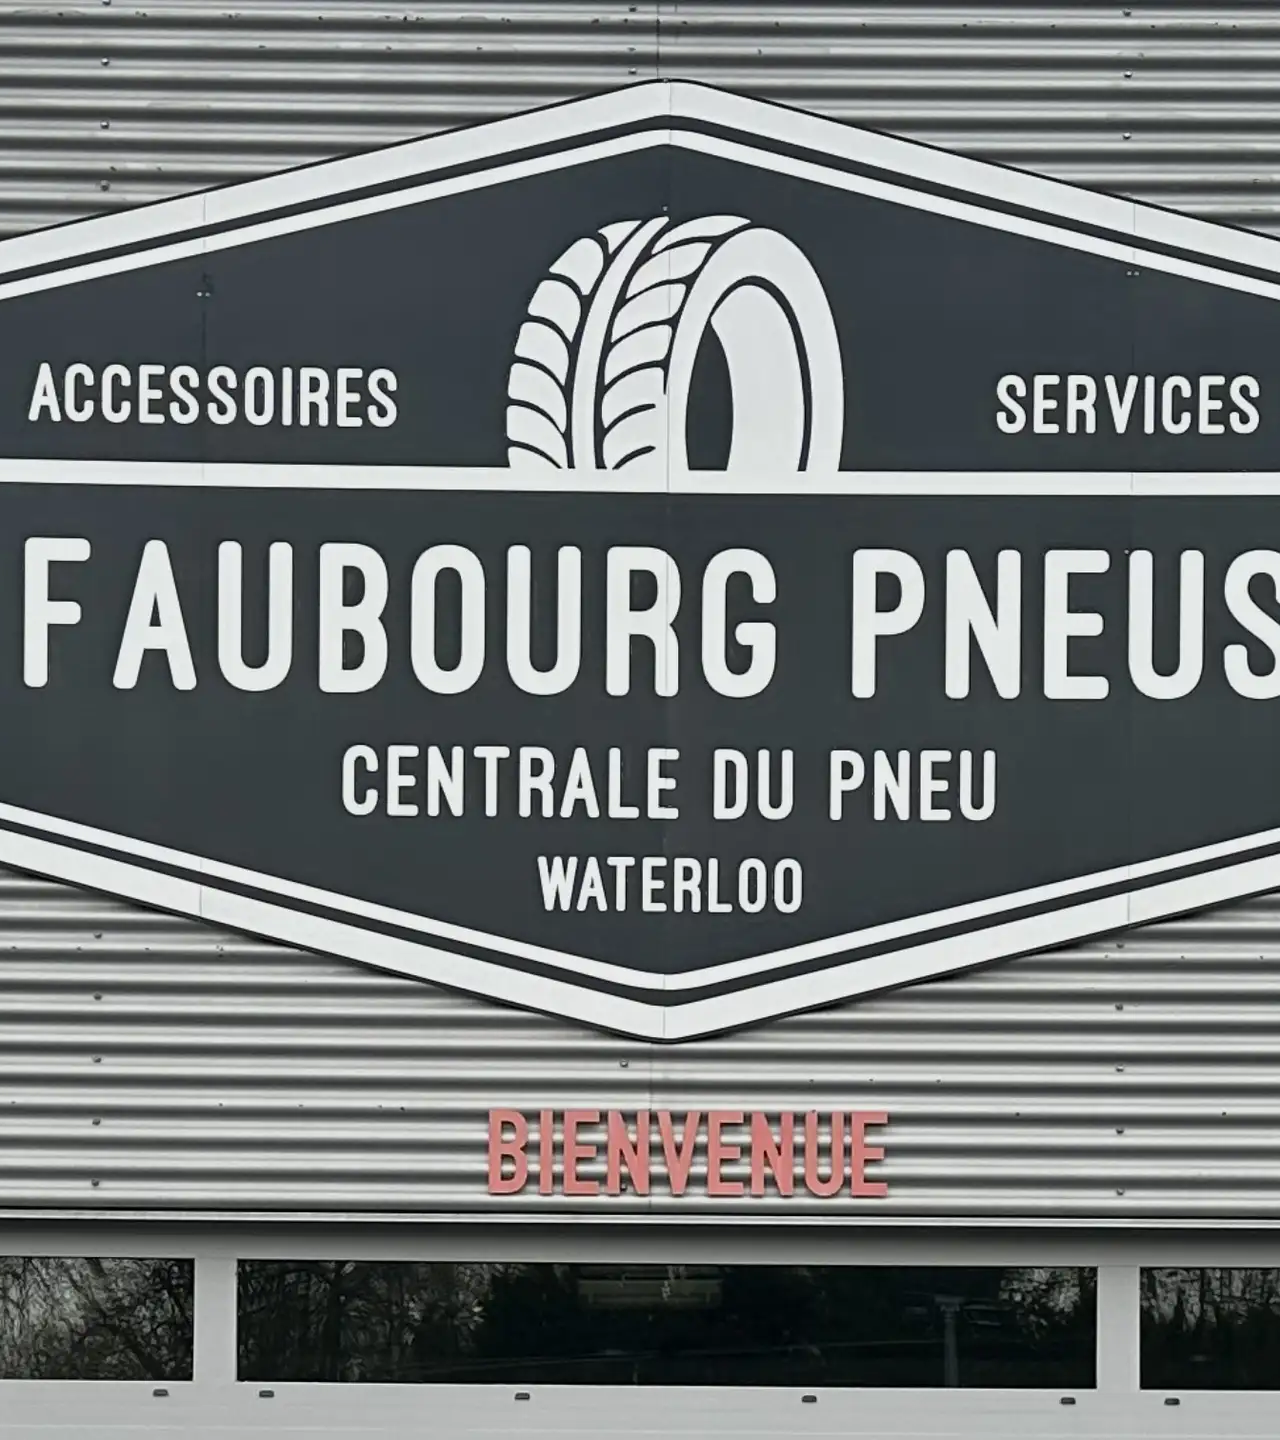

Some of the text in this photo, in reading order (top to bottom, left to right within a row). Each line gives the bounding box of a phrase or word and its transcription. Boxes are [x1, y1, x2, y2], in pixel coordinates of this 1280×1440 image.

[28, 362, 399, 428] ACCESSOIRES
[996, 374, 1261, 435] SERVICES
[23, 536, 778, 699] FAUBOURG
[341, 744, 998, 822] CENTRALE DU PNEU
[537, 856, 804, 914] WATERLOO
[487, 1107, 890, 1199] BIENVENUE
